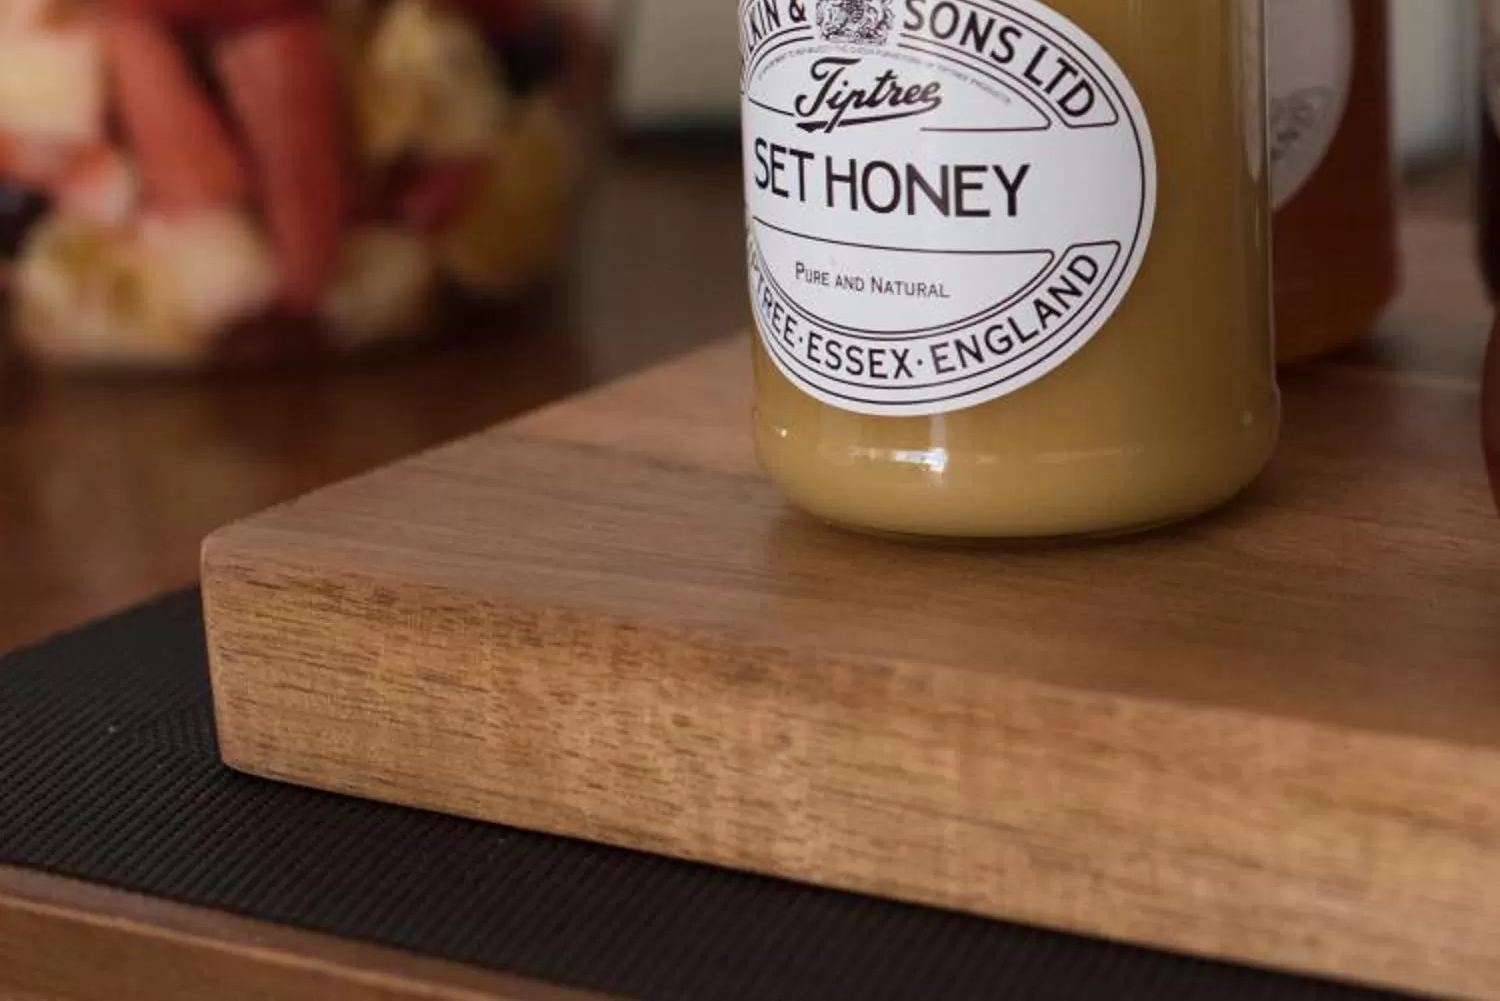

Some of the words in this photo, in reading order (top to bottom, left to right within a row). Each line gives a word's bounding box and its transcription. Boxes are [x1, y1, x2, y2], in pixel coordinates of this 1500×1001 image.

[795, 56, 942, 133] Tiptree
[1023, 44, 1095, 119] LTD
[754, 137, 814, 200] SET
[825, 157, 1031, 219] HONEY
[806, 331, 914, 380] ESSEX
[931, 252, 1099, 376] ENGLAND
